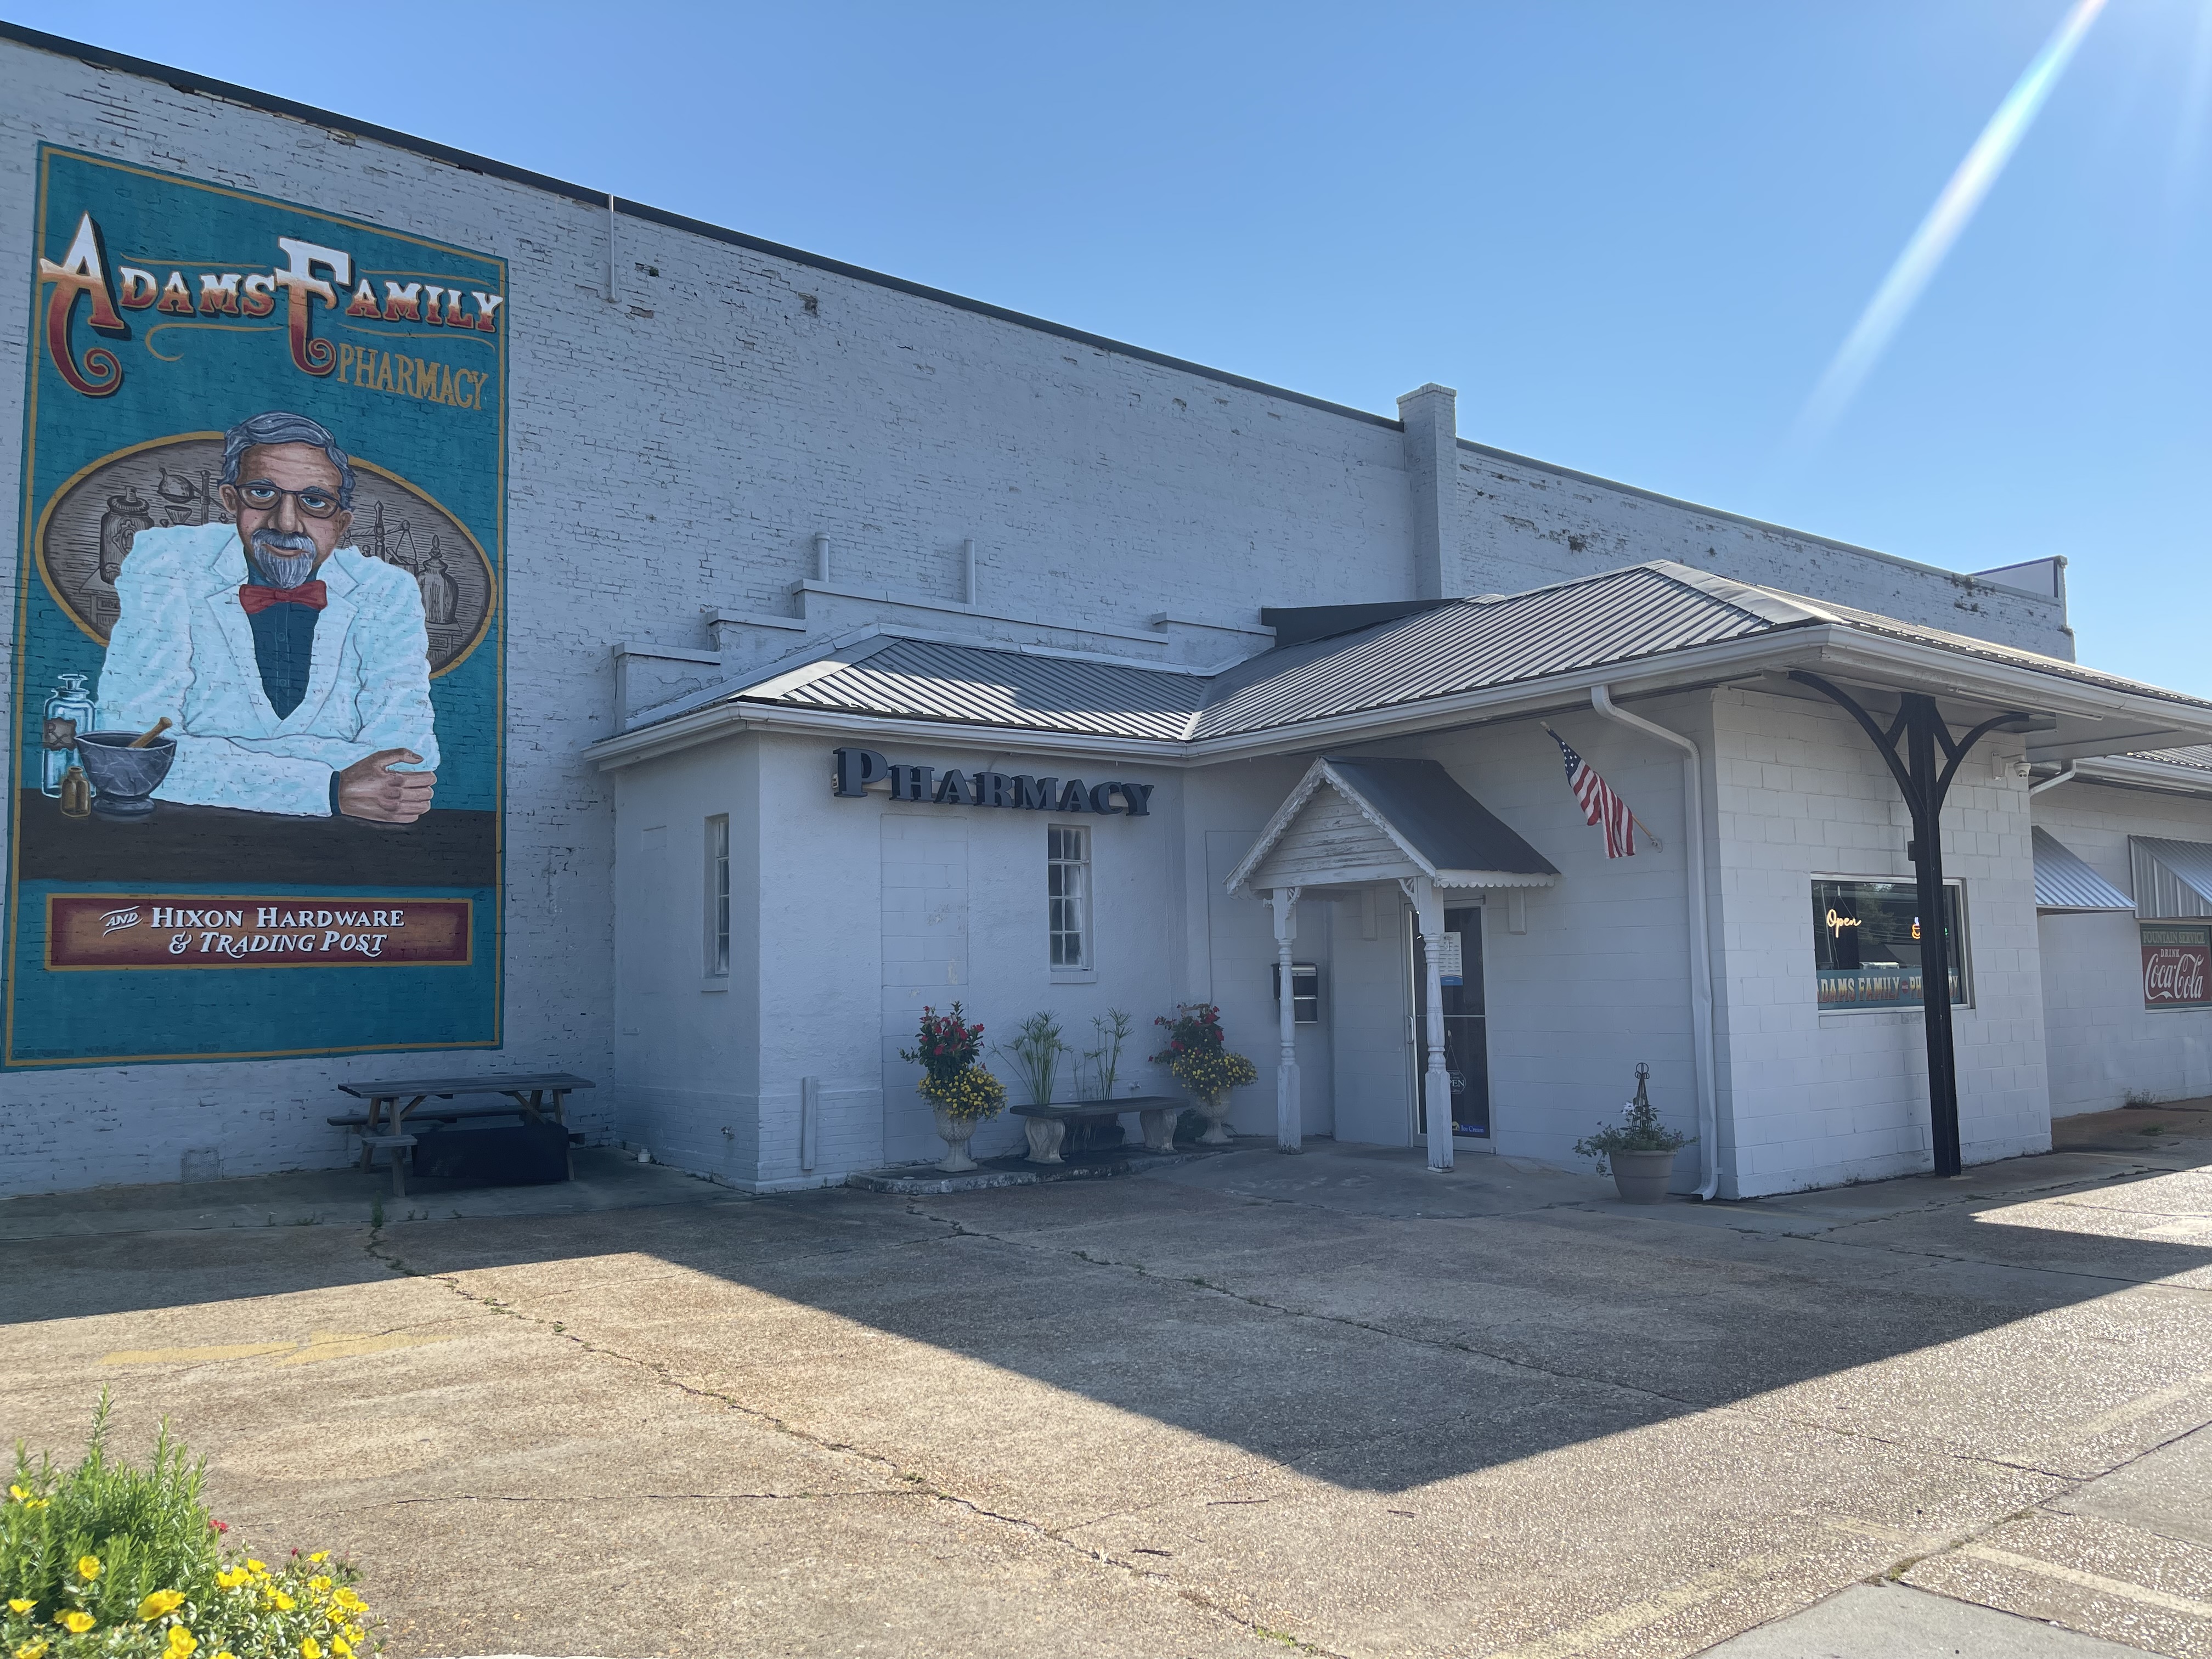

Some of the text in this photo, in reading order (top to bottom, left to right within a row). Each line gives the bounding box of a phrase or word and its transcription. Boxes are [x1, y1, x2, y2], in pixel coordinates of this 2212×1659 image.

[40, 211, 503, 397] ADAMS FAMILY
[337, 342, 489, 411] PHARMACY
[832, 747, 1155, 817] PHARMACY
[150, 907, 243, 928] HIXON
[257, 907, 404, 928] HARDWARE
[1826, 909, 1862, 938] Open
[169, 929, 388, 958] & TRADING POST
[2142, 931, 2205, 944] FOUNTAIN SERVICE
[2160, 949, 2180, 957] DRINK
[1858, 976, 1900, 1002] FAMILY
[2145, 953, 2204, 1000] Coca-Cola
